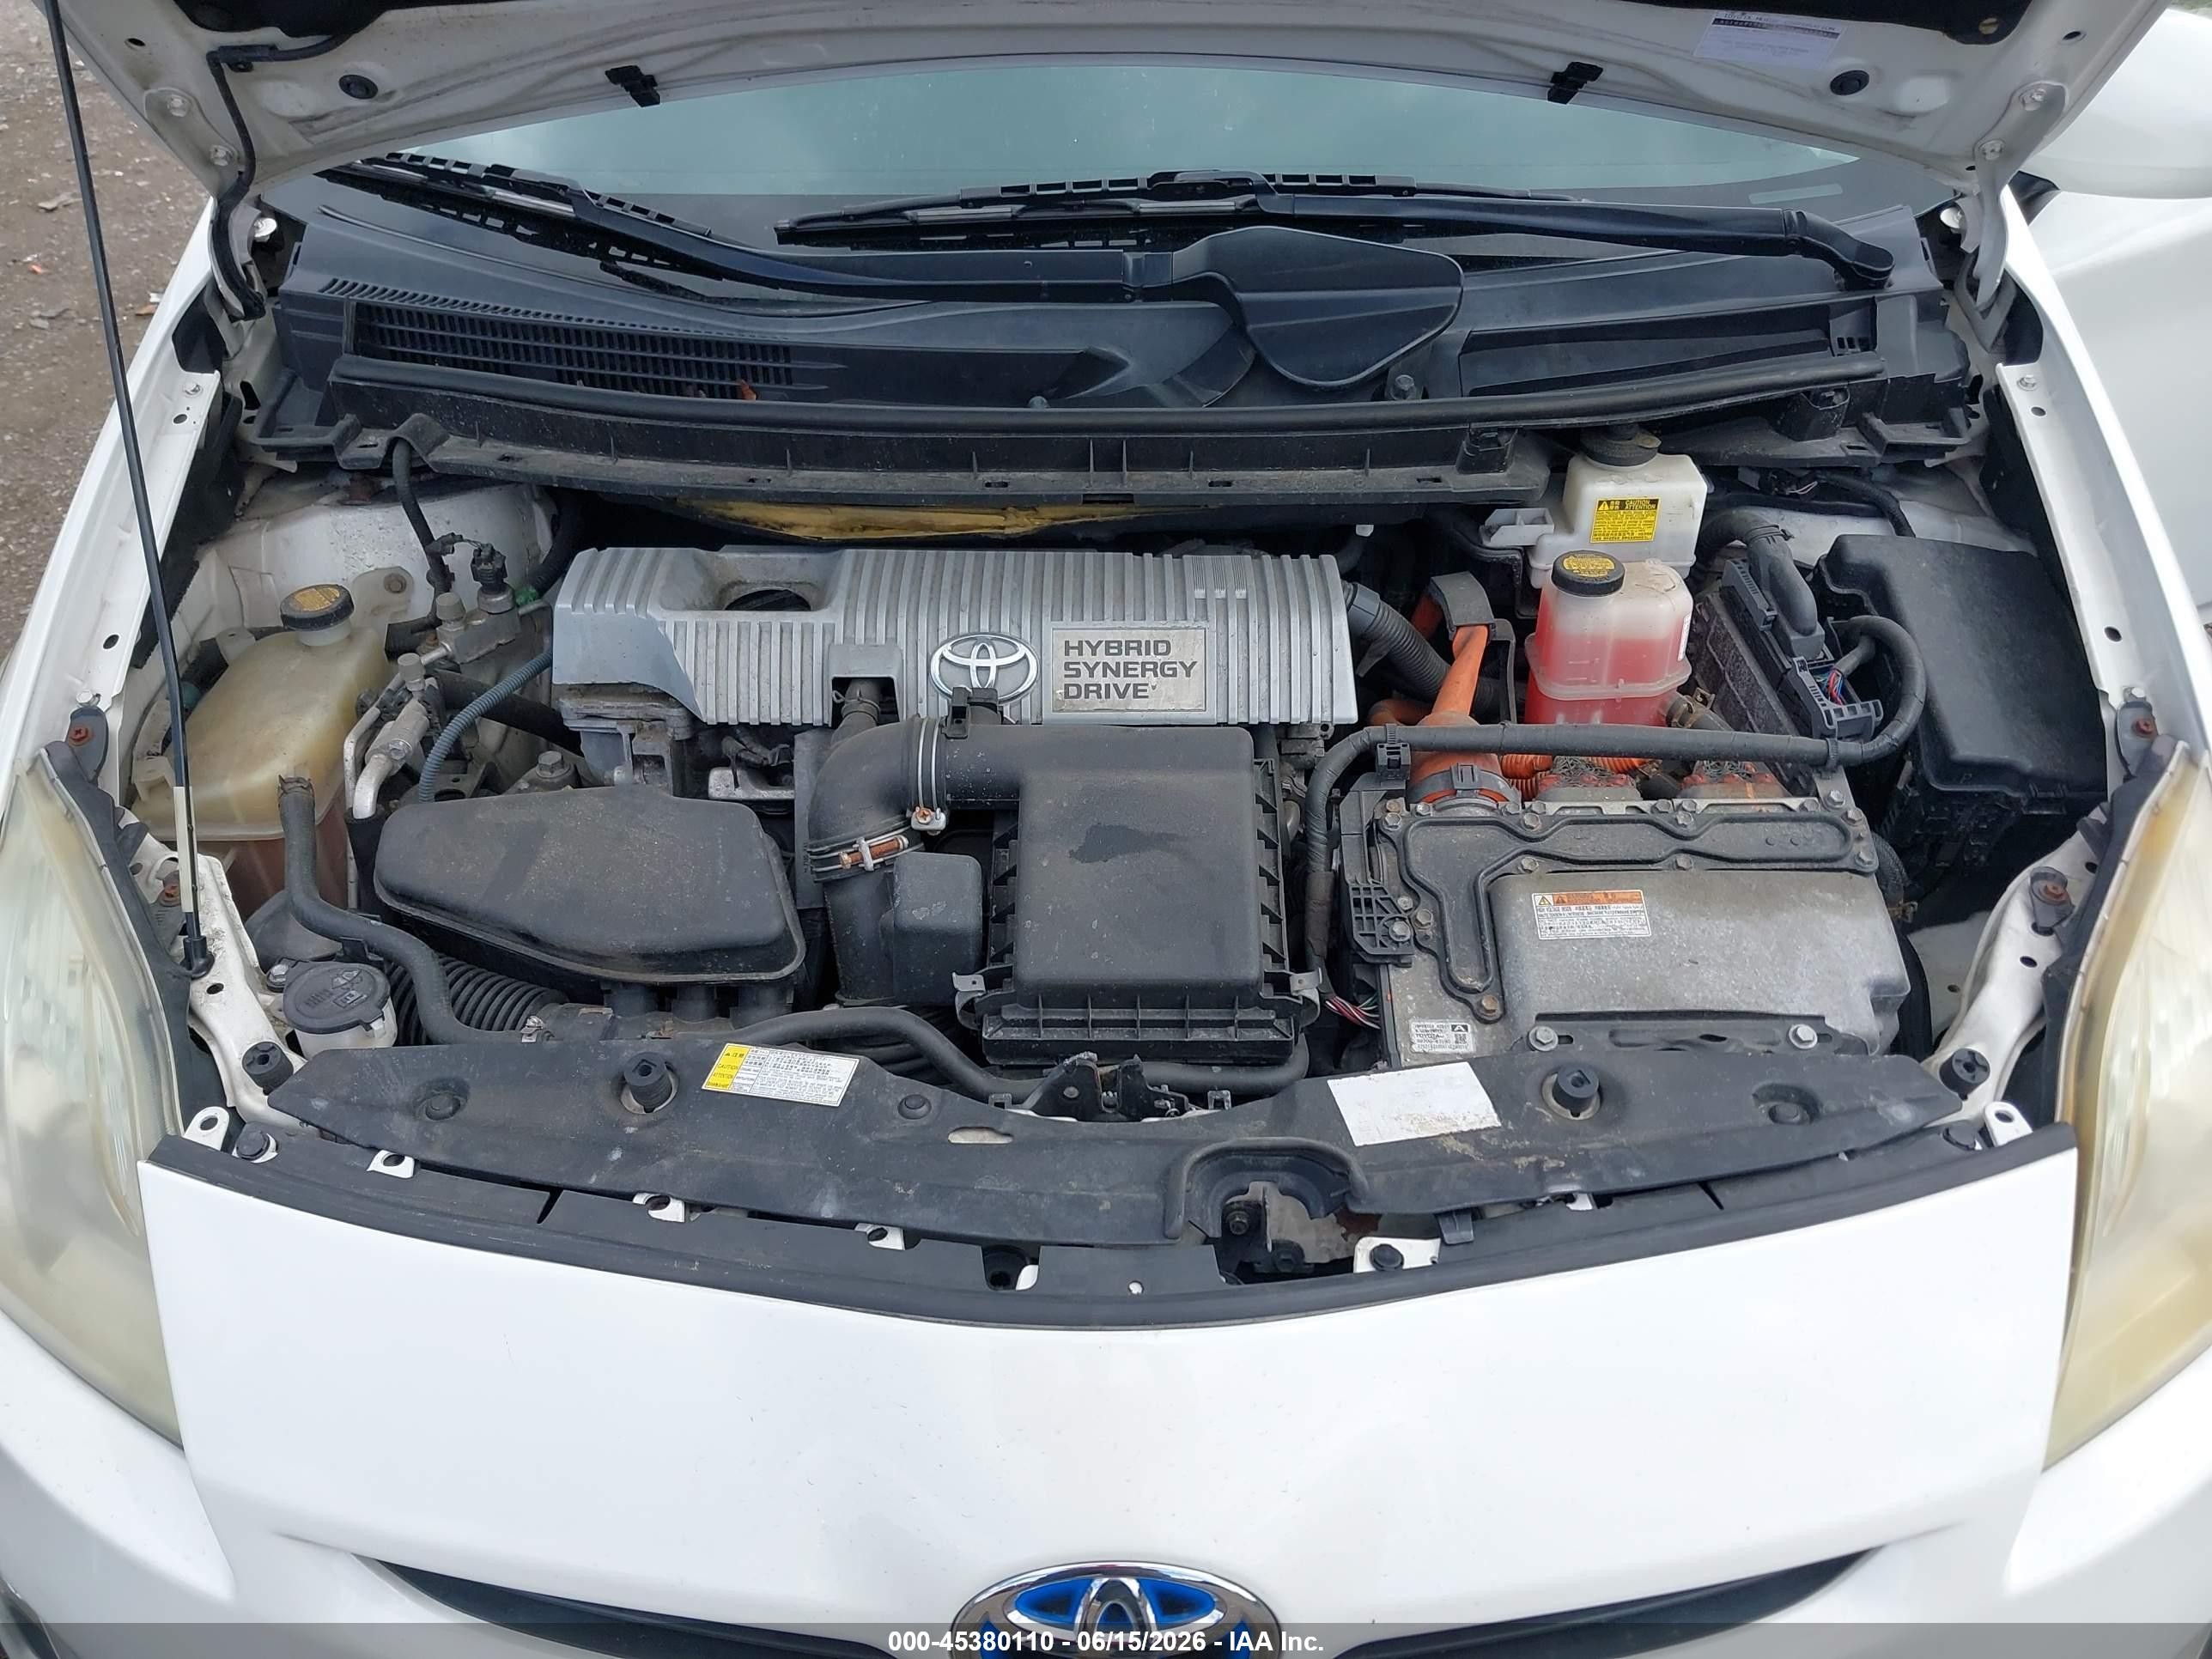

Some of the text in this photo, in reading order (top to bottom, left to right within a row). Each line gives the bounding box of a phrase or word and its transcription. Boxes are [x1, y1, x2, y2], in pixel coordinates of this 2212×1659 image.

[1064, 640, 1171, 657] HYBRID
[1064, 661, 1198, 678] SYNERGY
[1064, 683, 1149, 700] DRIVE
